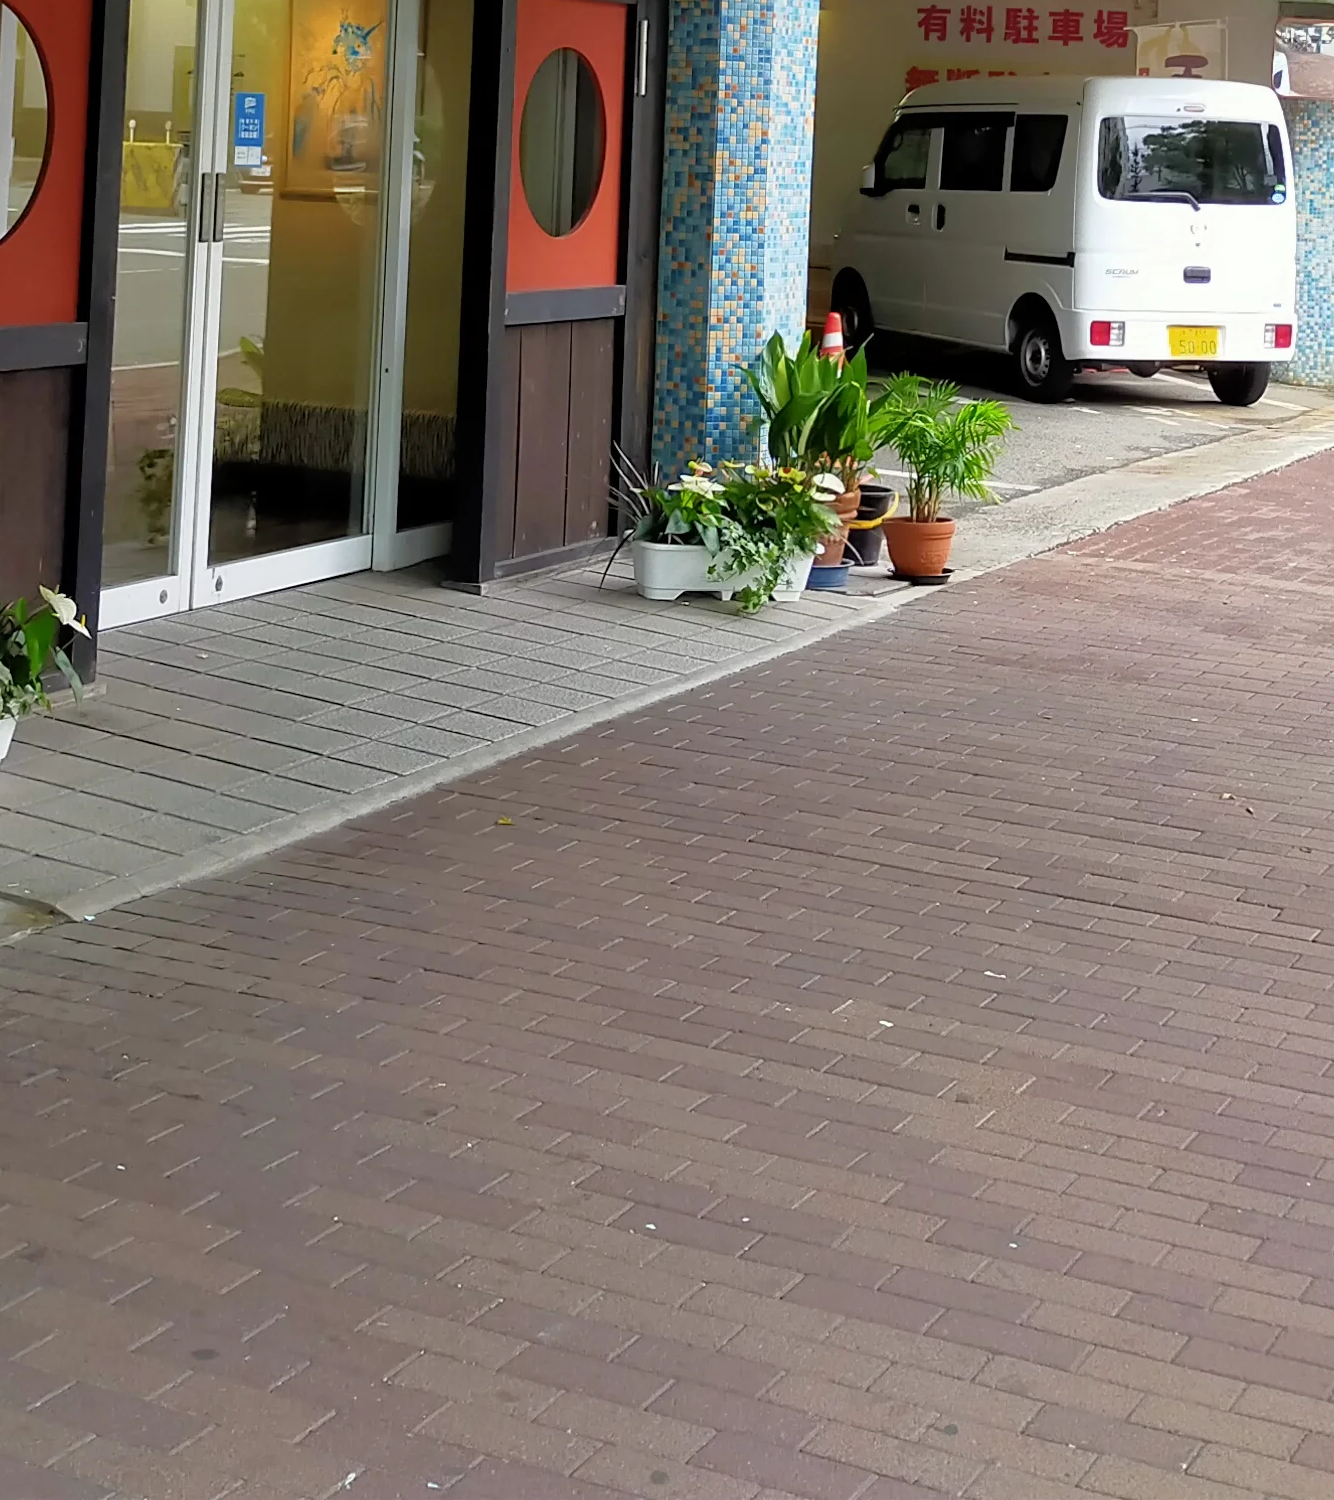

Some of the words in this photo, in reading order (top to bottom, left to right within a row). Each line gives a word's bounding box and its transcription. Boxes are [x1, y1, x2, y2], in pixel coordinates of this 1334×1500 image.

[916, 4, 1132, 49] 有料駐車場
